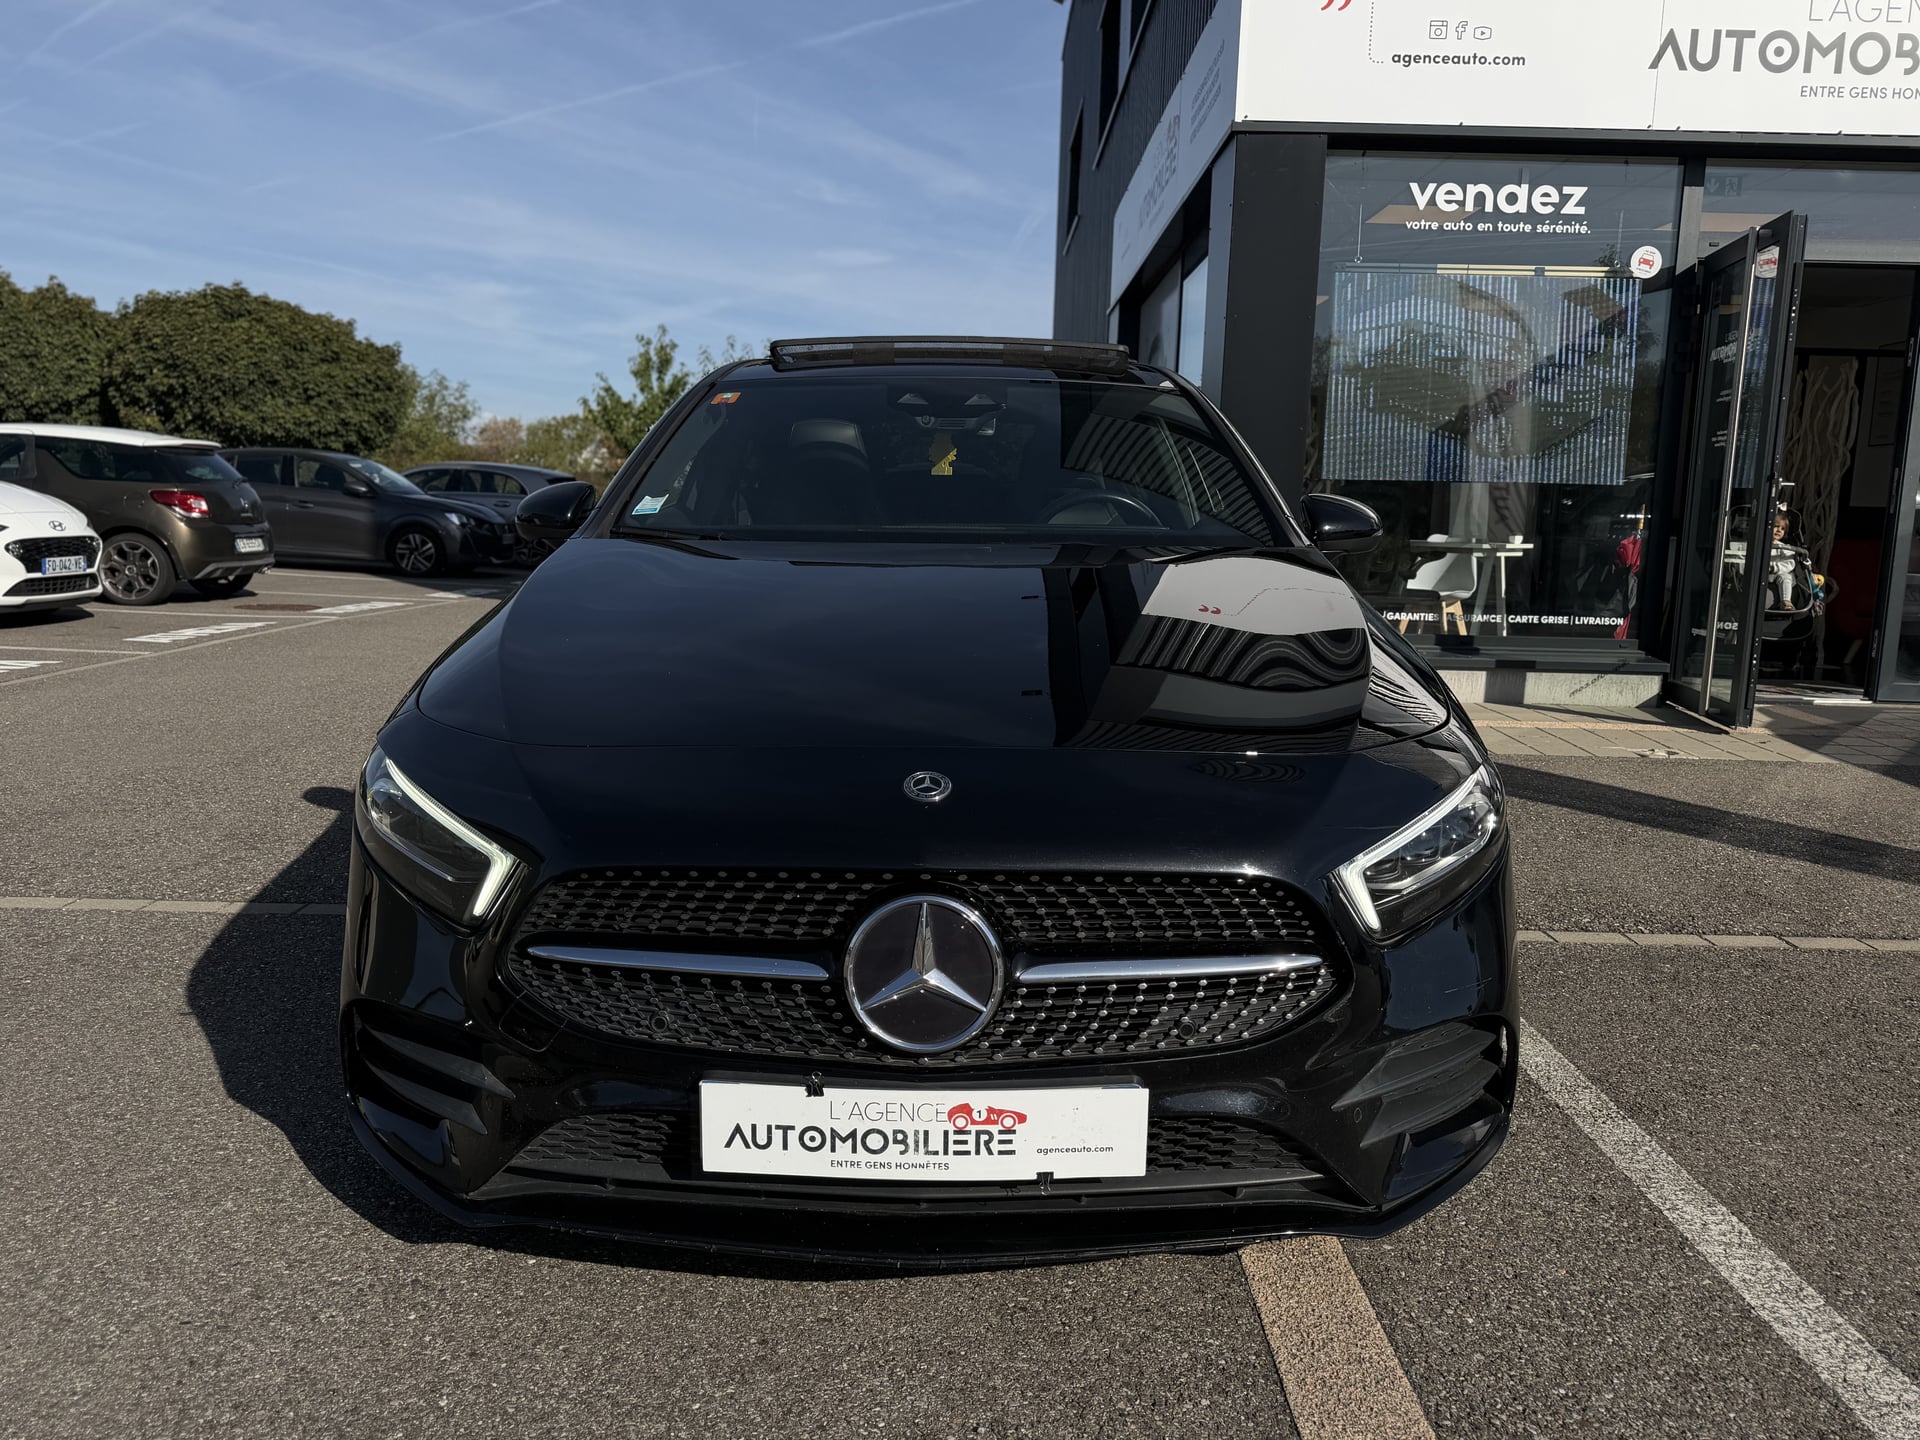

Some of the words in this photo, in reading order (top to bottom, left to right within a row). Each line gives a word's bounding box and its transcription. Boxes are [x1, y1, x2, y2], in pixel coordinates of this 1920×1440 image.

[1391, 52, 1526, 68] agenceauto.com
[1800, 85, 1846, 98] ENTRE
[1849, 86, 1888, 99] GENS
[1409, 182, 1588, 215] vendez
[1405, 219, 1439, 231] votre
[1443, 219, 1473, 232] auto
[1477, 222, 1493, 232] en
[1498, 220, 1532, 233] toute
[1536, 219, 1591, 234] sérénité.
[1386, 612, 1440, 621] GARANTIES
[1508, 615, 1540, 624] CARTE
[1541, 615, 1569, 624] GRISE
[1575, 616, 1624, 626] LIVRAISON
[830, 1100, 948, 1122] L'AGENCE
[1036, 1145, 1114, 1156] agenceauto.com
[830, 1159, 862, 1169] ENTRE
[865, 1161, 893, 1170] GENS
